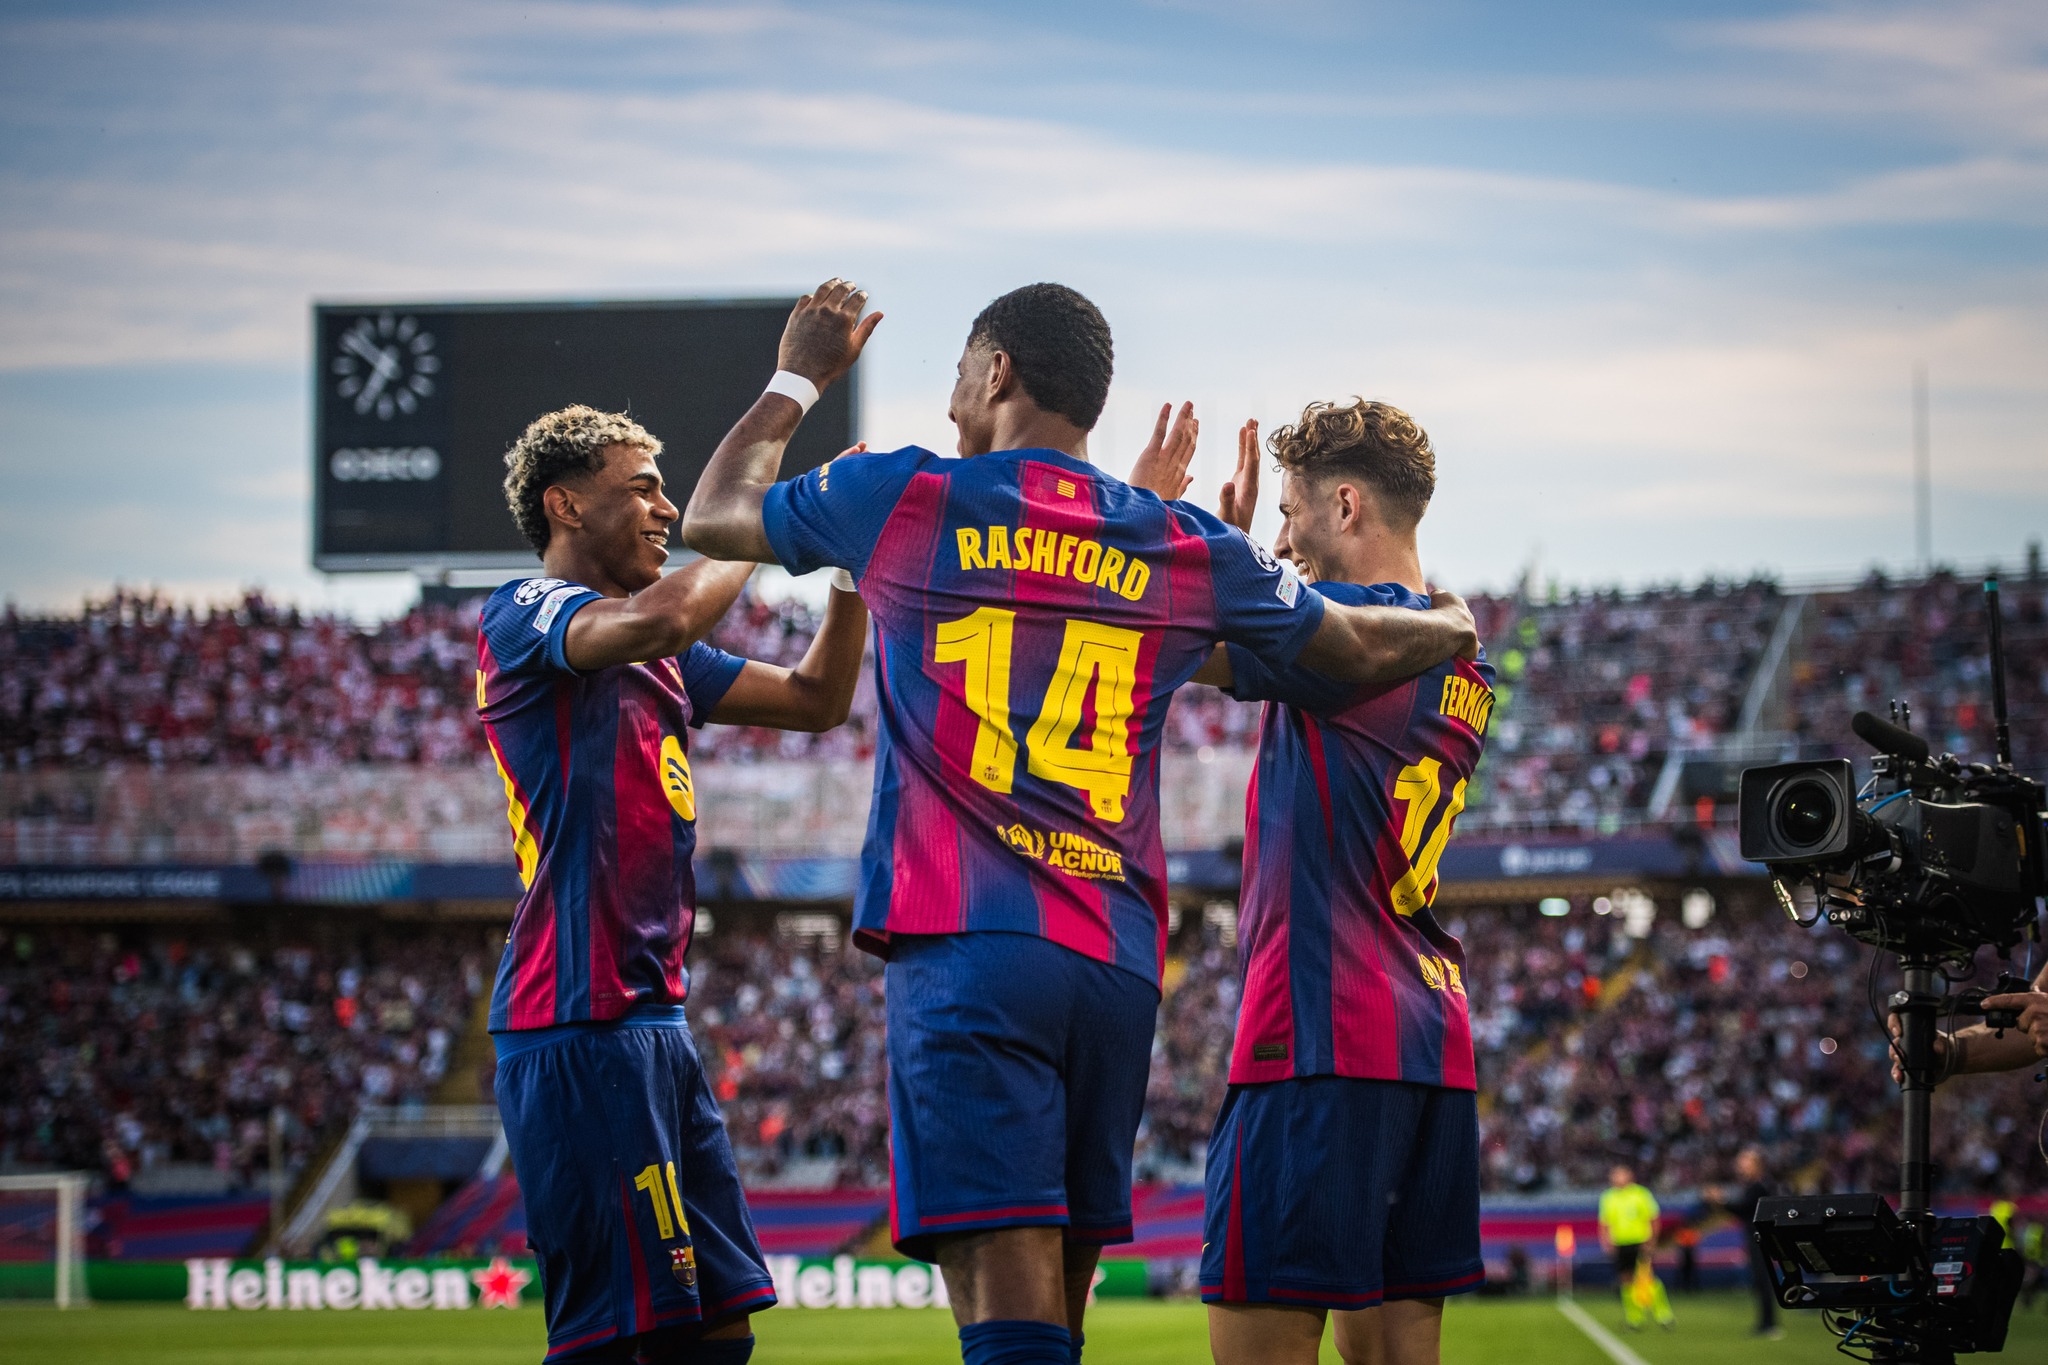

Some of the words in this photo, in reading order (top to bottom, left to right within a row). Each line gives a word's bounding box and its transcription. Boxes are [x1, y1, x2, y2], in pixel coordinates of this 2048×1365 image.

[956, 526, 1150, 601] RASHFORD
[934, 606, 1144, 823] 14
[1047, 849, 1123, 874] ACNUR
[1073, 870, 1101, 880] Refugee
[1101, 873, 1126, 882] Agency
[185, 1257, 471, 1310] Heineken
[766, 1254, 950, 1309] Heine
